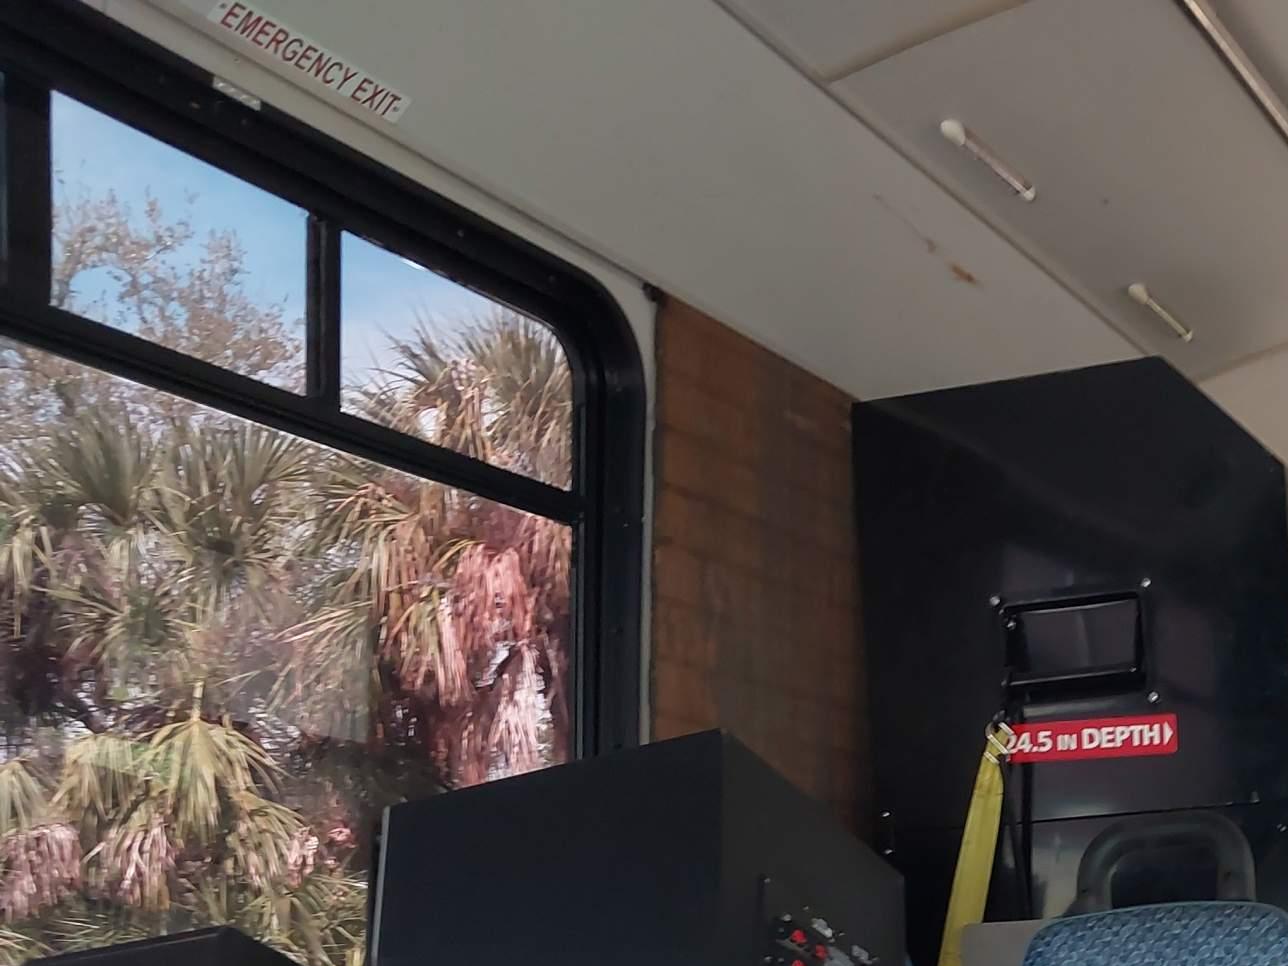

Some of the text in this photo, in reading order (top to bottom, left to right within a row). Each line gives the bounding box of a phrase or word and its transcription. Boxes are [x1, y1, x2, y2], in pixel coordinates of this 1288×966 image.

[220, 1, 402, 116] EMERGENCY EXIT
[1007, 730, 1053, 753] 24.5
[1082, 723, 1161, 749] DEPTH
